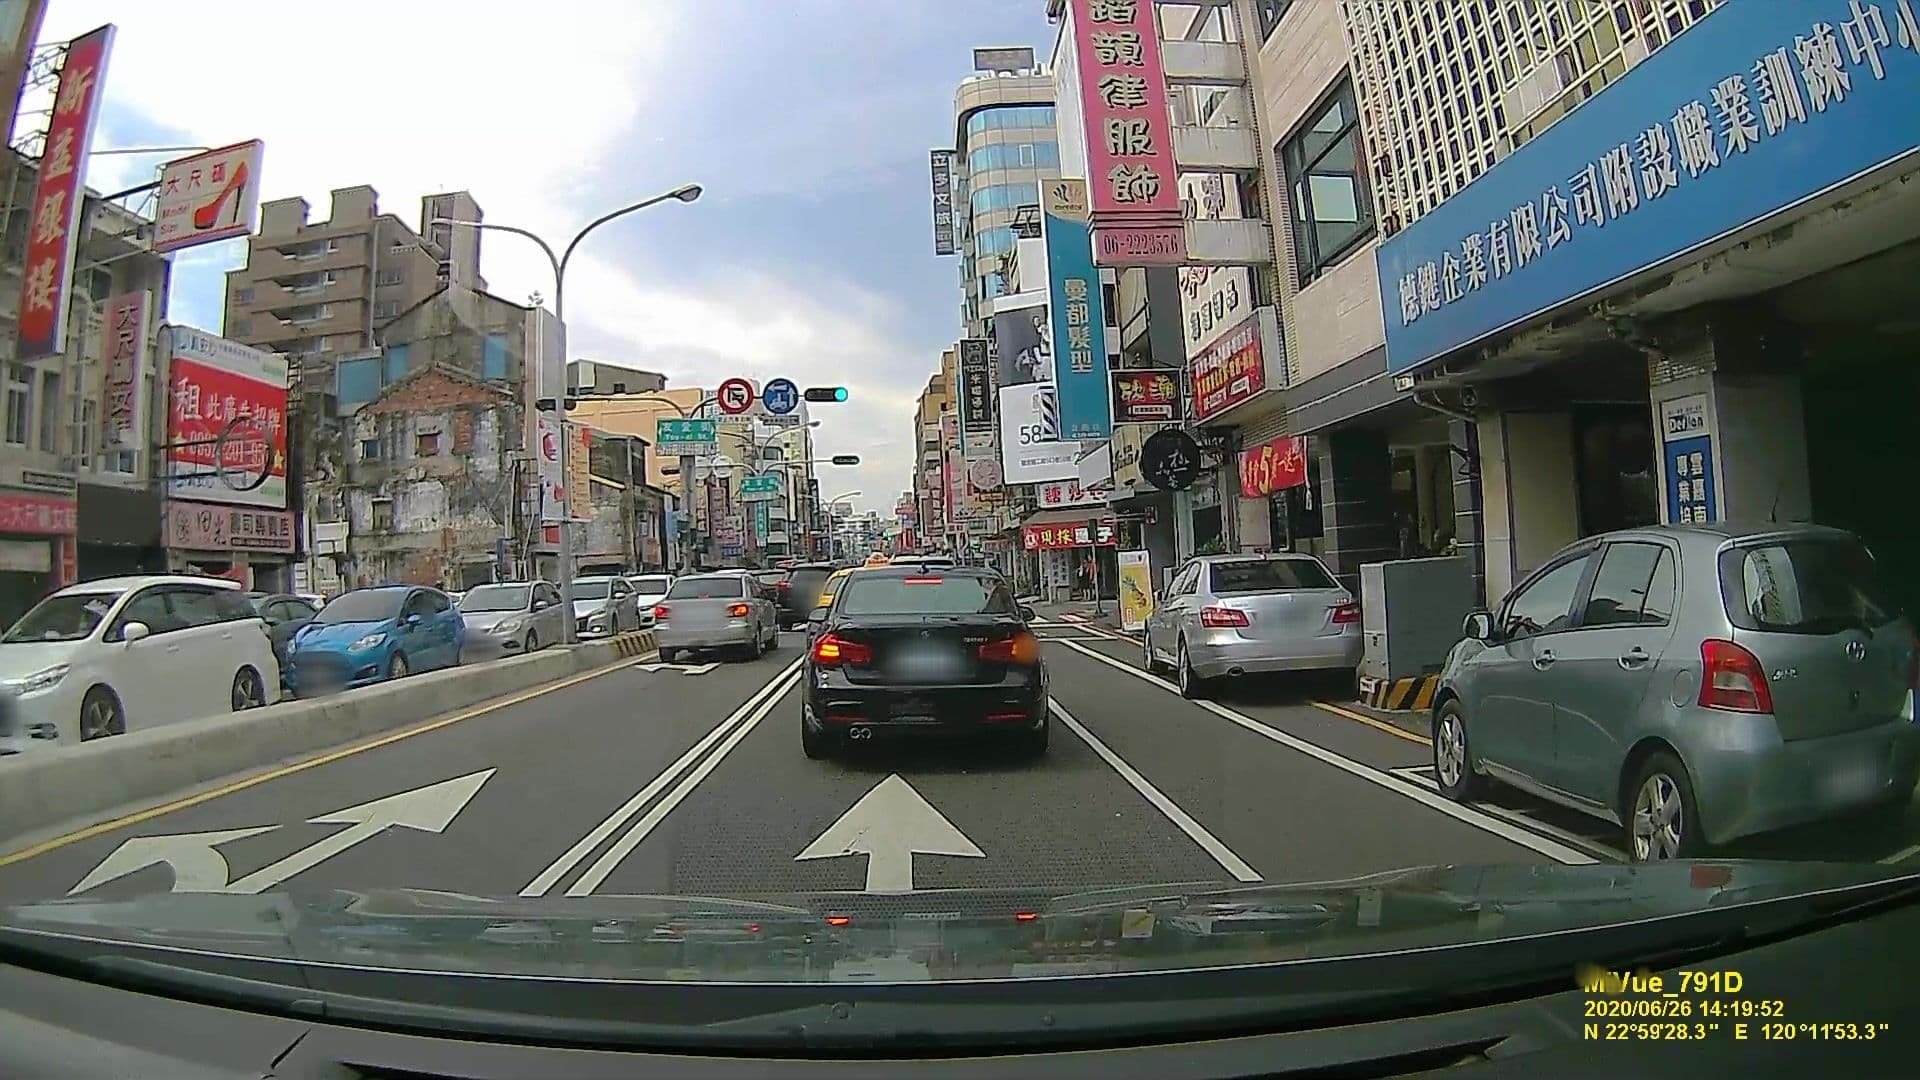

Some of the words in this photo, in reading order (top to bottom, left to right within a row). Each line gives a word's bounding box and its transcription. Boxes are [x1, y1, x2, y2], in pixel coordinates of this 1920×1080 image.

[1104, 235, 1178, 254] 06-2223576
[1064, 279, 1094, 373] 曼都髮型
[175, 376, 202, 422] 租
